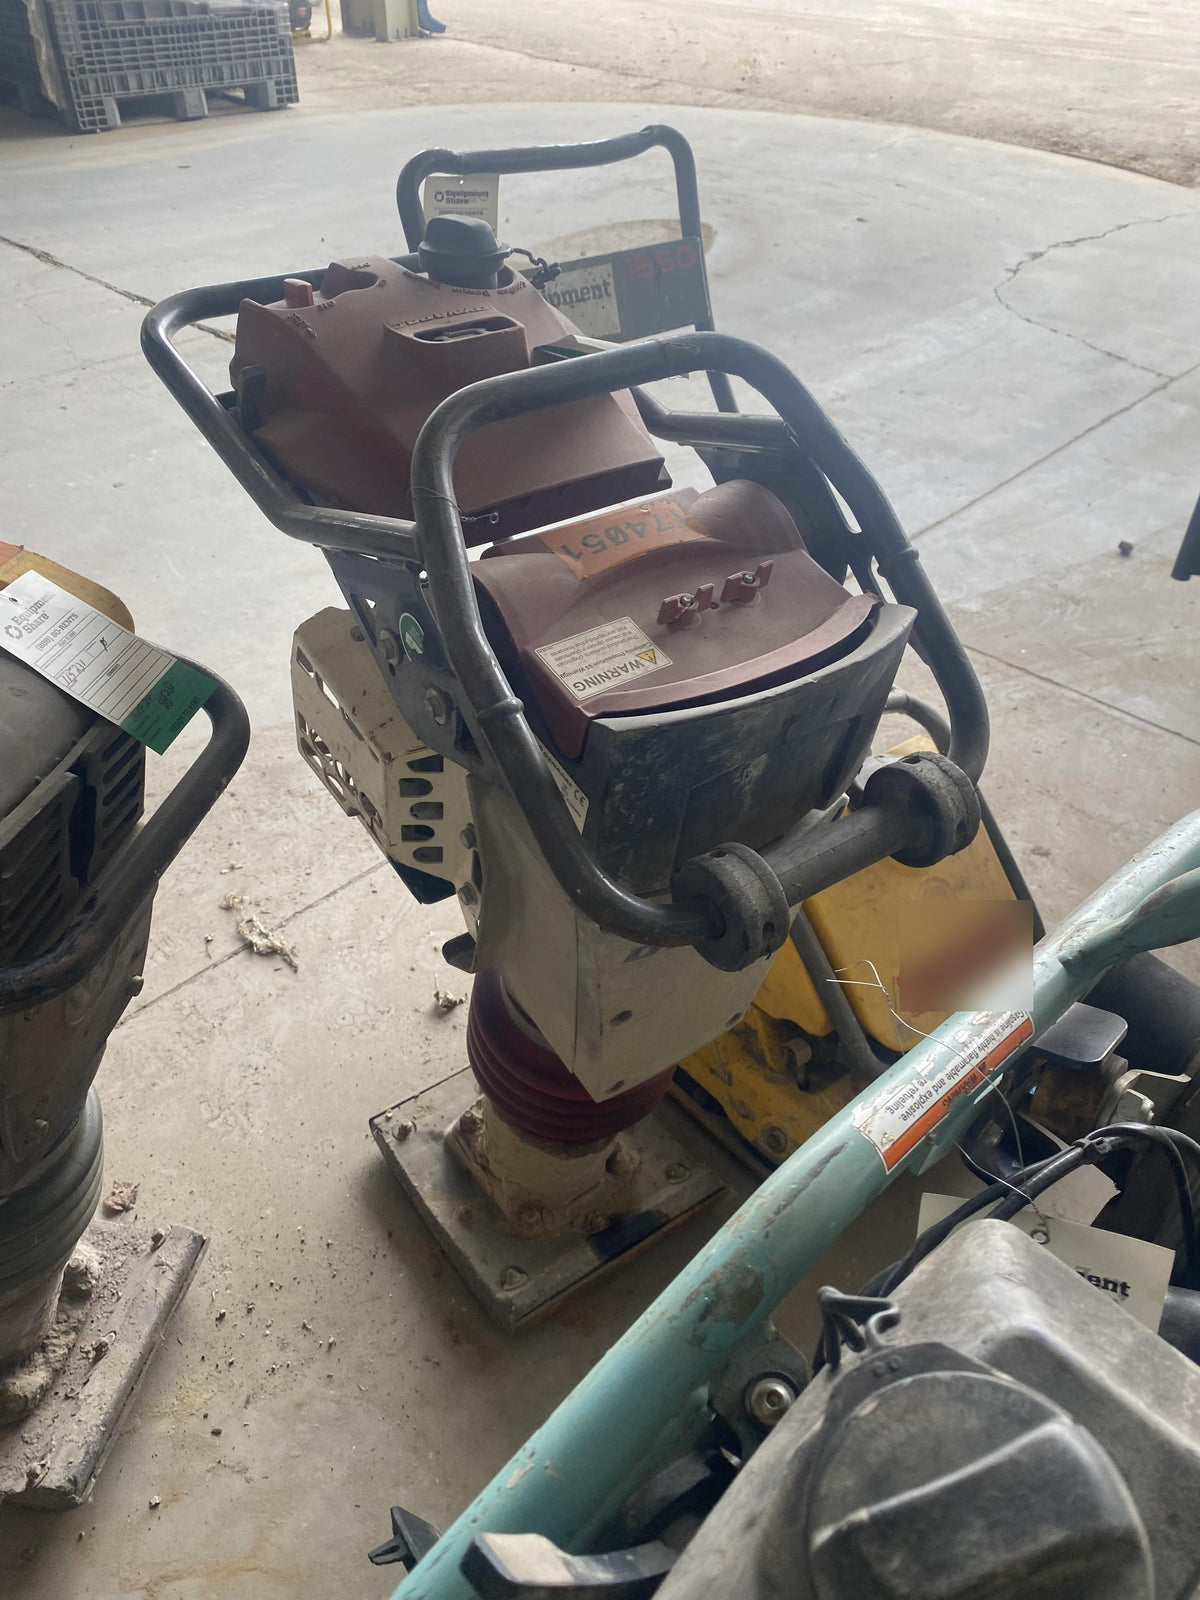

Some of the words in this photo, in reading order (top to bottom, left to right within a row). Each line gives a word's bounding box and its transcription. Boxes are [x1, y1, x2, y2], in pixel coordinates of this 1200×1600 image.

[542, 280, 612, 307] ipment
[22, 612, 50, 634] Share
[572, 659, 645, 692] WARNING
[994, 1028, 1002, 1039] is
[933, 1078, 946, 1093] and
